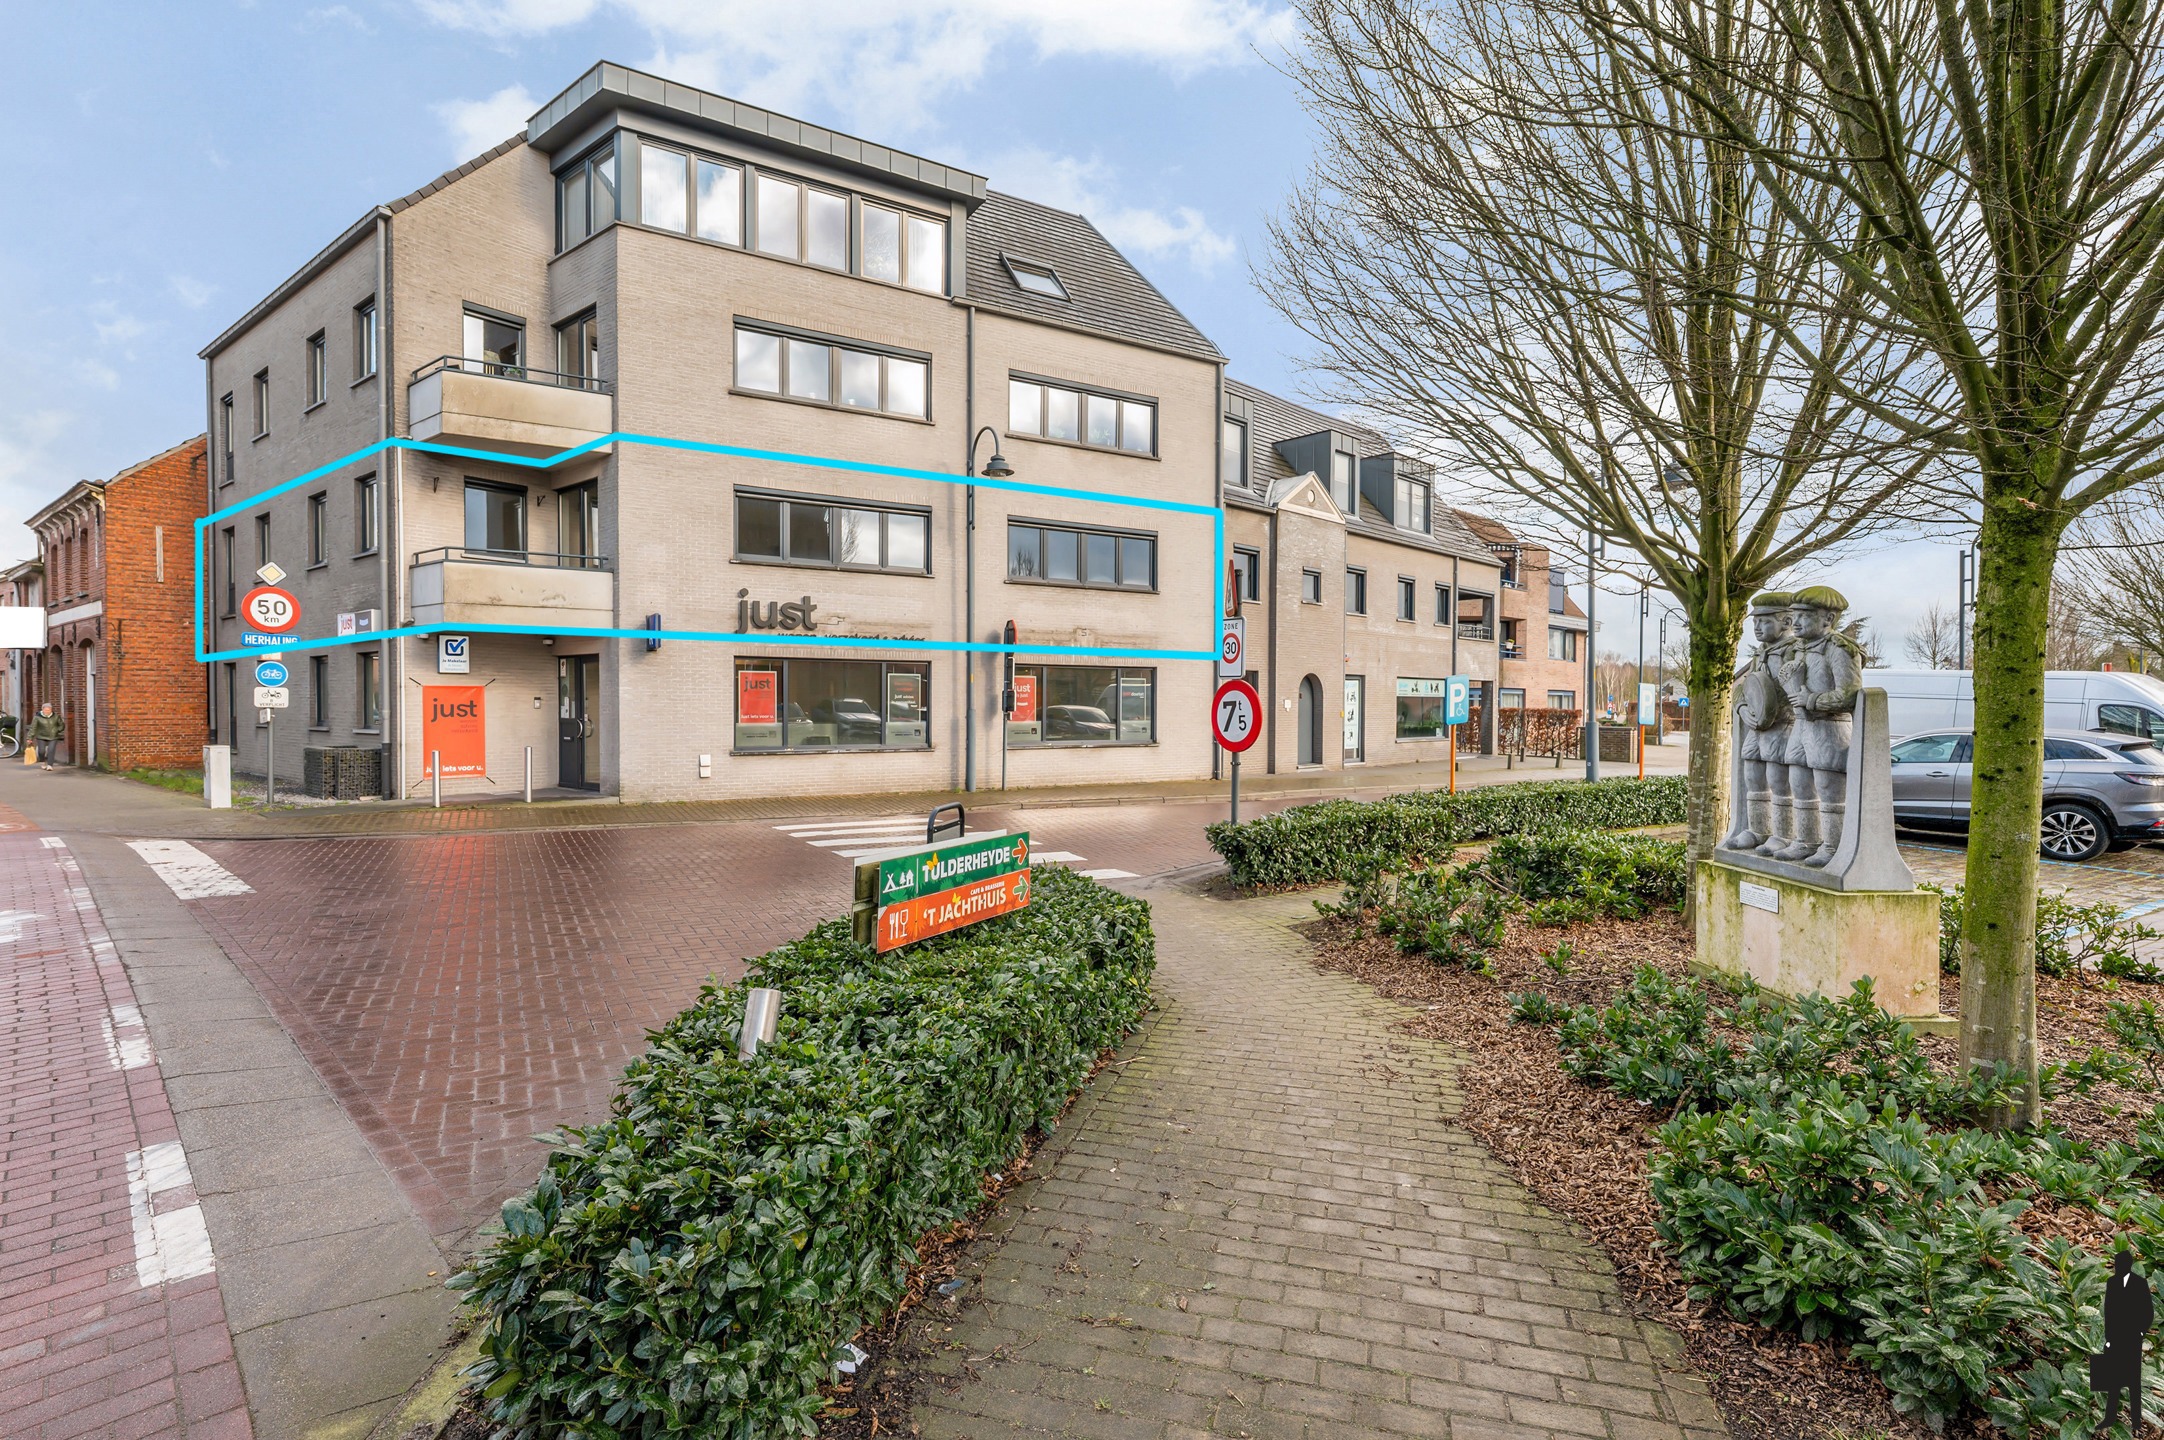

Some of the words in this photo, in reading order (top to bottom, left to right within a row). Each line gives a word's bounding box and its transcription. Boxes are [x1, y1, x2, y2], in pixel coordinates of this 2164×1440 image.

[257, 600, 286, 615] 50
[734, 587, 818, 634] just
[340, 615, 352, 634] just
[1223, 622, 1239, 630] ZONE
[1225, 641, 1237, 655] 30
[744, 677, 771, 692] just
[431, 698, 478, 723] just
[1238, 700, 1242, 711] t
[1449, 683, 1466, 718] P
[1641, 690, 1653, 718] P
[1223, 700, 1237, 732] 7
[1238, 715, 1247, 731] 5
[922, 846, 1010, 882] TULDERHEYDE
[938, 887, 1007, 924] JACHTHUIS
